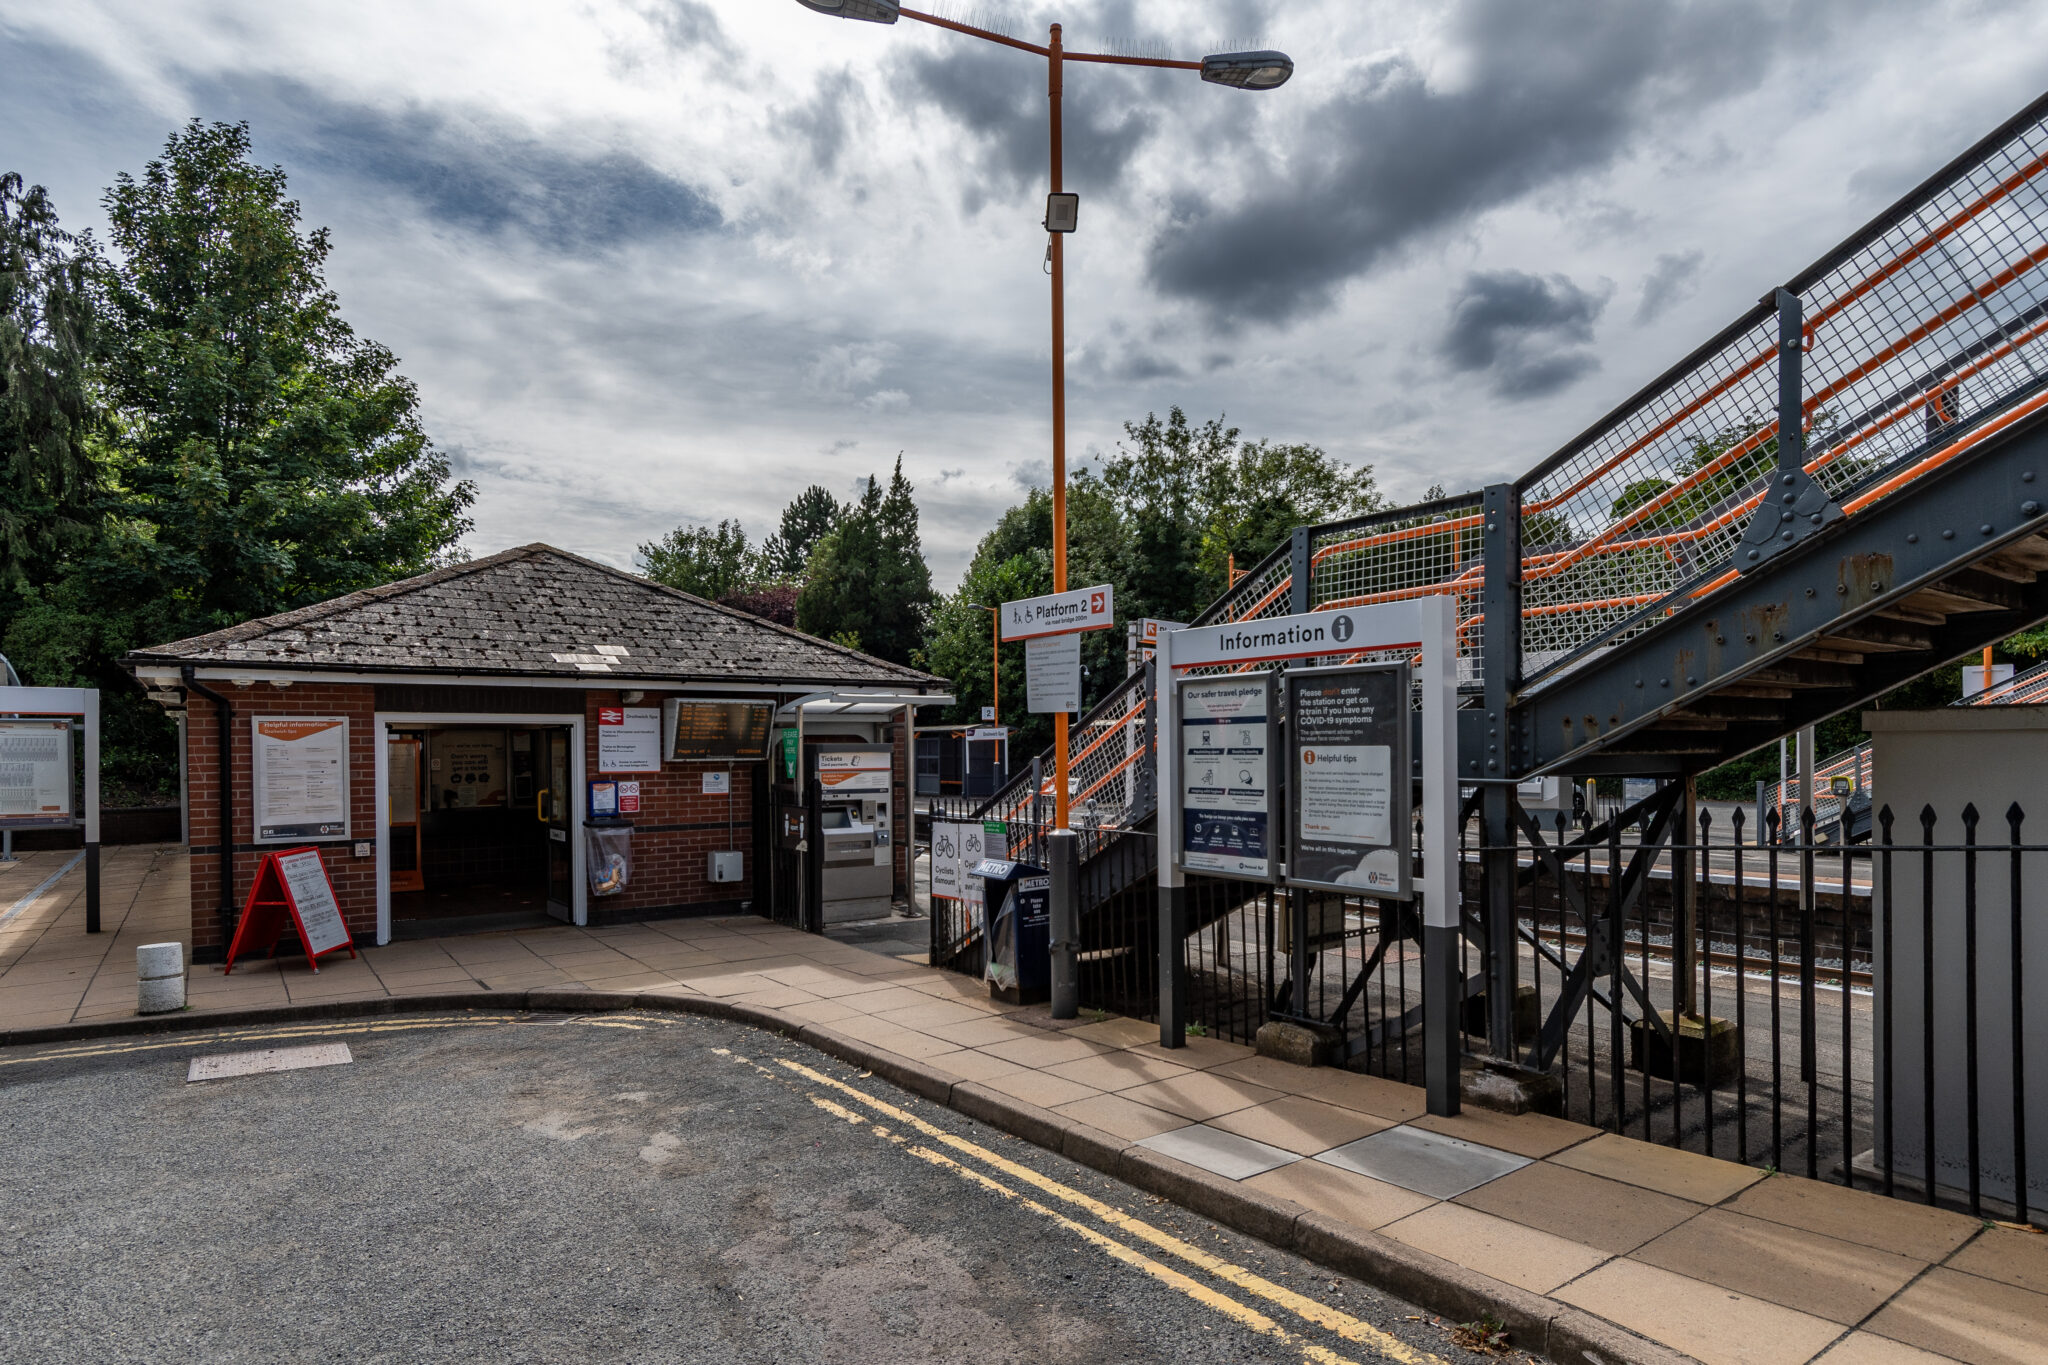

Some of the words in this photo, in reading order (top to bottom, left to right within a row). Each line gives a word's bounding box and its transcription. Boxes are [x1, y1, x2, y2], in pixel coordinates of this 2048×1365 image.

[1036, 603, 1078, 618] Platform
[1081, 600, 1087, 613] 2
[1220, 625, 1324, 650] Information
[1201, 690, 1216, 698] safer
[1239, 688, 1262, 696] pledge
[1300, 698, 1311, 706] the
[1346, 698, 1357, 706] get
[1329, 708, 1342, 716] you
[1344, 706, 1360, 714] have
[1362, 706, 1374, 714] any
[1300, 717, 1334, 725] COVID-19
[1335, 716, 1372, 725] symptoms
[1317, 755, 1341, 763] Helpful
[1343, 754, 1357, 763] tips
[935, 865, 954, 875] Cyclists
[978, 861, 1008, 874] METRO
[935, 876, 955, 885] dismount
[1026, 879, 1049, 888] METRO
